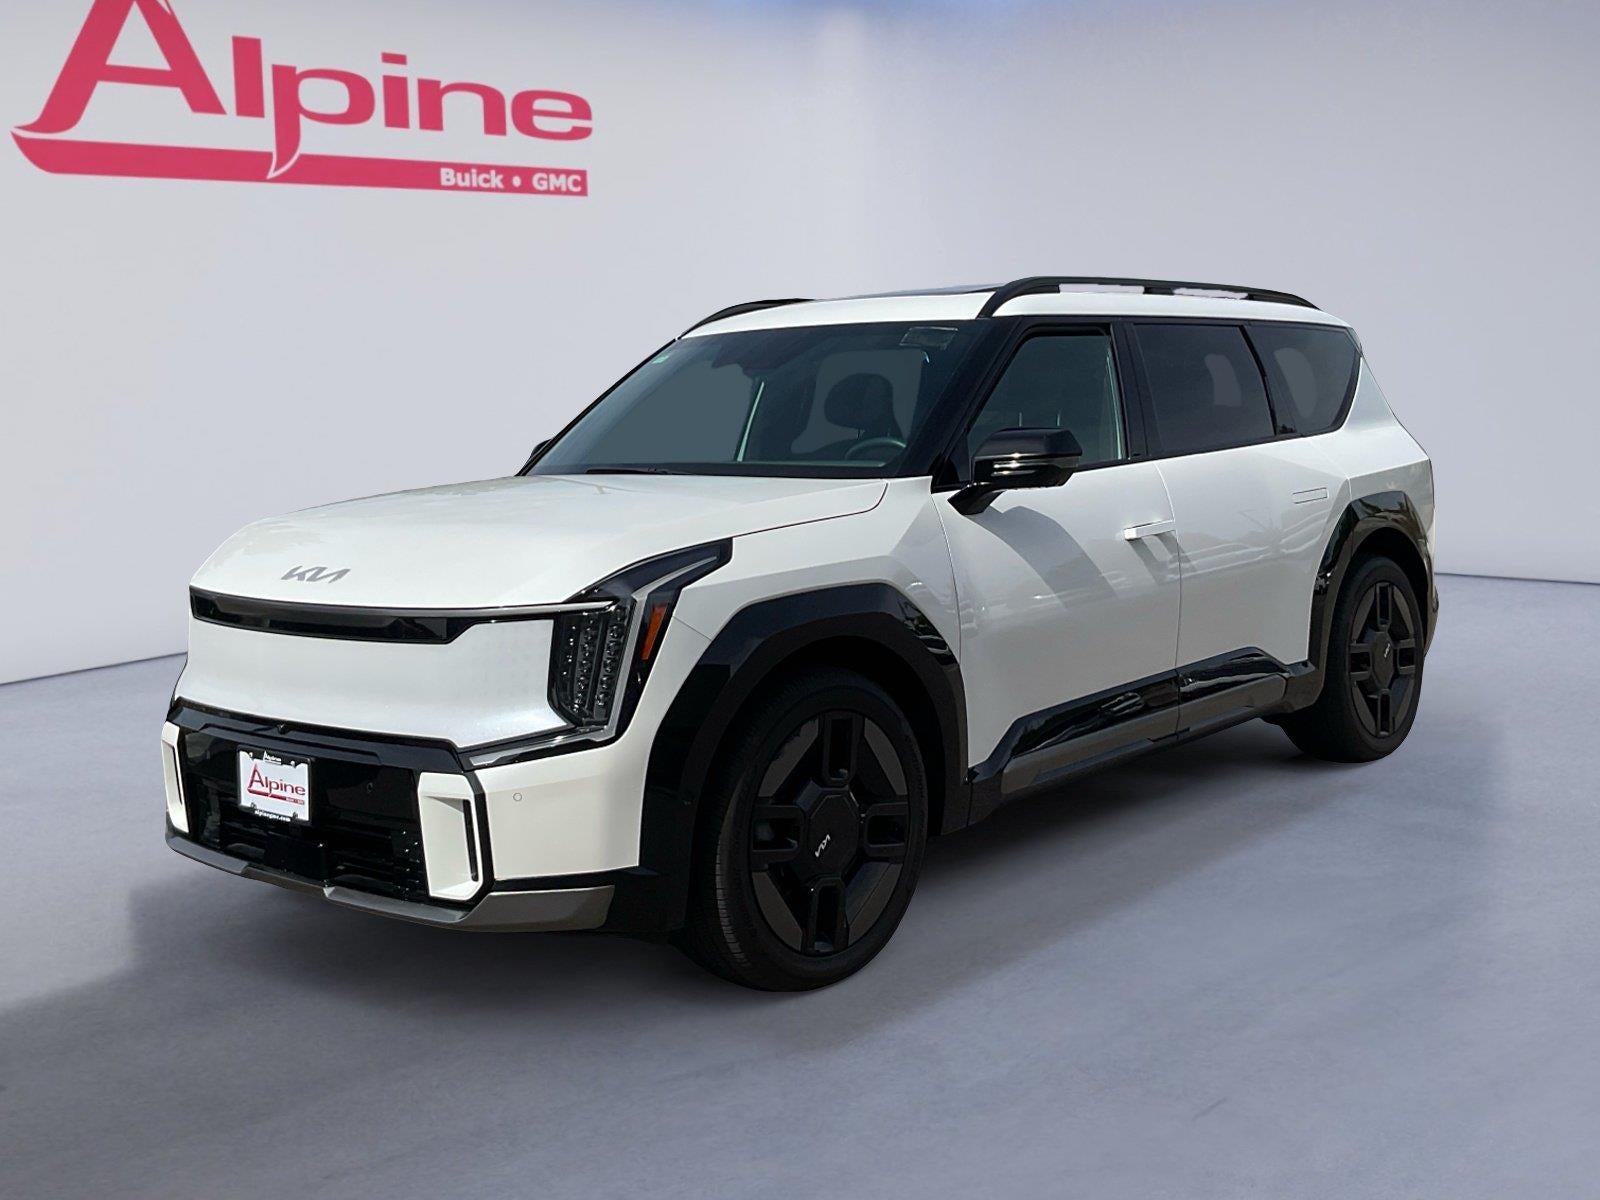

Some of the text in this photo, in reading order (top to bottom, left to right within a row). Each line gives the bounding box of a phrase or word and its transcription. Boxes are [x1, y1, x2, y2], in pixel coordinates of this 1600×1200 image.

[14, 0, 592, 178] Alpine
[440, 167, 582, 192] Buick GMC
[247, 763, 306, 796] Alpine
